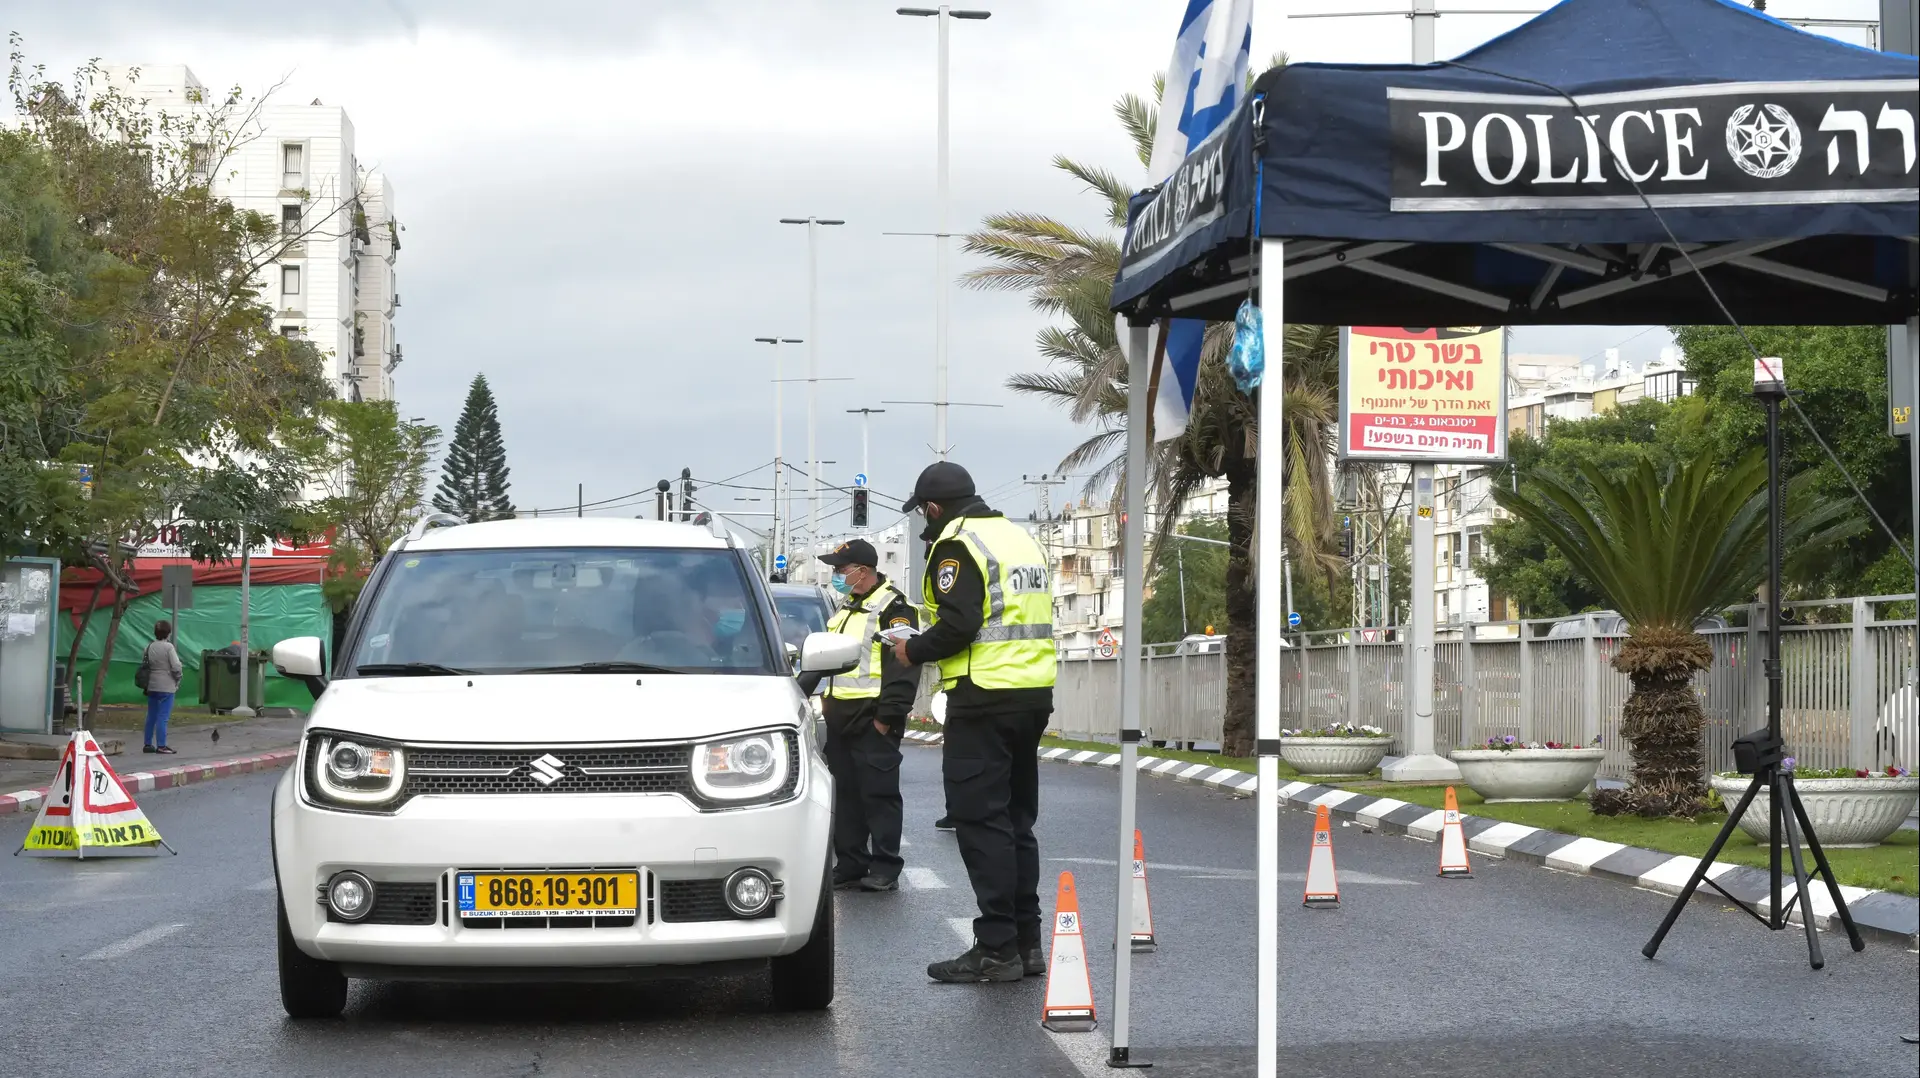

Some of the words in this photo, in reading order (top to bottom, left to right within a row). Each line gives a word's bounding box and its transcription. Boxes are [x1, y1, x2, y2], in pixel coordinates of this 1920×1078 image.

[1418, 106, 1709, 187] POLICE
[1369, 341, 1416, 364] טרי
[1423, 342, 1483, 364] בשר
[1378, 368, 1474, 391] ואיכותי
[1361, 397, 1407, 411] יוחננוף!
[1409, 396, 1428, 409] של
[1431, 398, 1464, 411] הדרך
[1466, 399, 1491, 410] זאת
[1374, 415, 1407, 426] בת-ים
[1428, 416, 1477, 427] ניסנבאום
[1368, 429, 1415, 445] בשפע!
[1417, 433, 1449, 447] חינם
[1452, 437, 1483, 450] חניה
[1419, 507, 1431, 516] 97
[461, 885, 472, 900] IL
